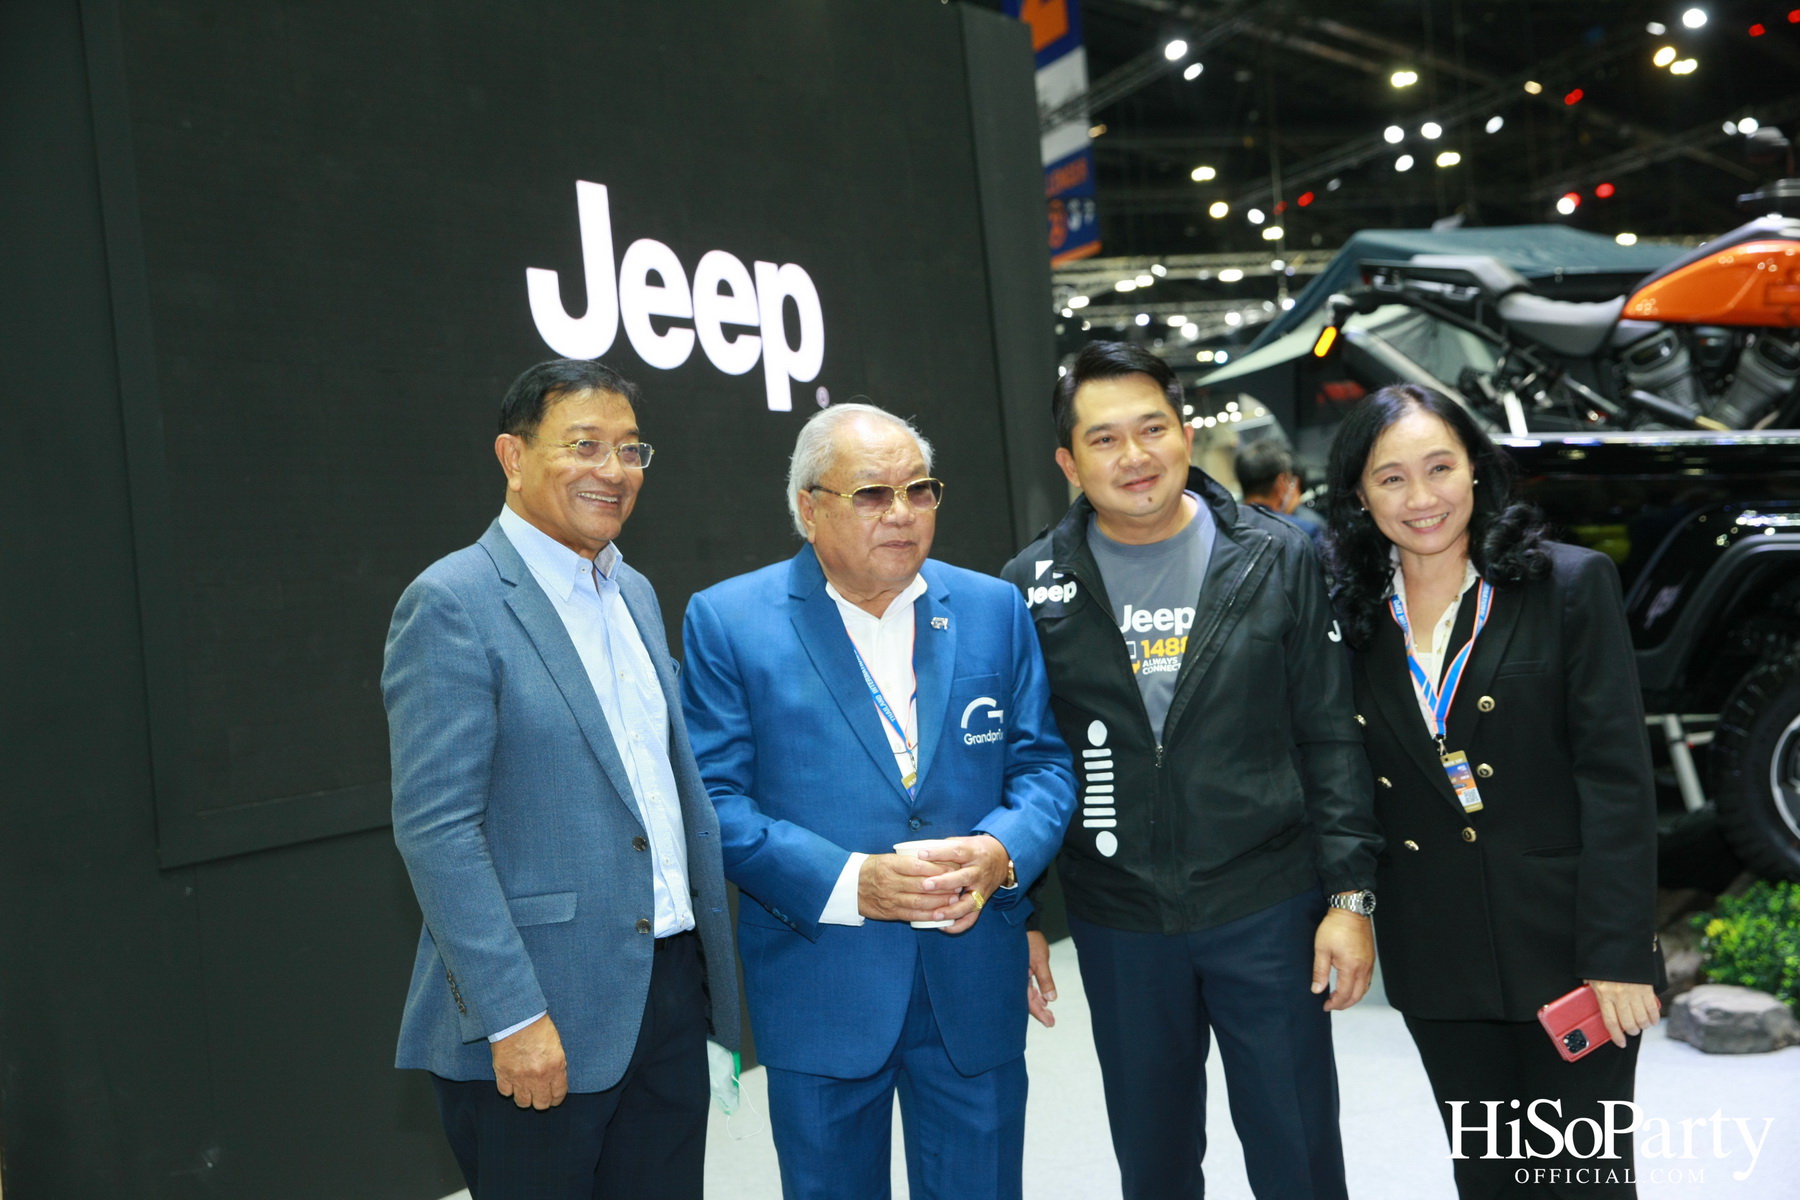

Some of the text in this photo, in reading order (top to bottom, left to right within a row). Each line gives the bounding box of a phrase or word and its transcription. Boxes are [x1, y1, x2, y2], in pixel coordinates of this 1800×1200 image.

[526, 180, 825, 412] Jeep
[1024, 580, 1077, 609] Jeep
[1120, 604, 1196, 635] Jeep
[1142, 656, 1178, 668] ALWAYS
[875, 694, 896, 722] THAILAND
